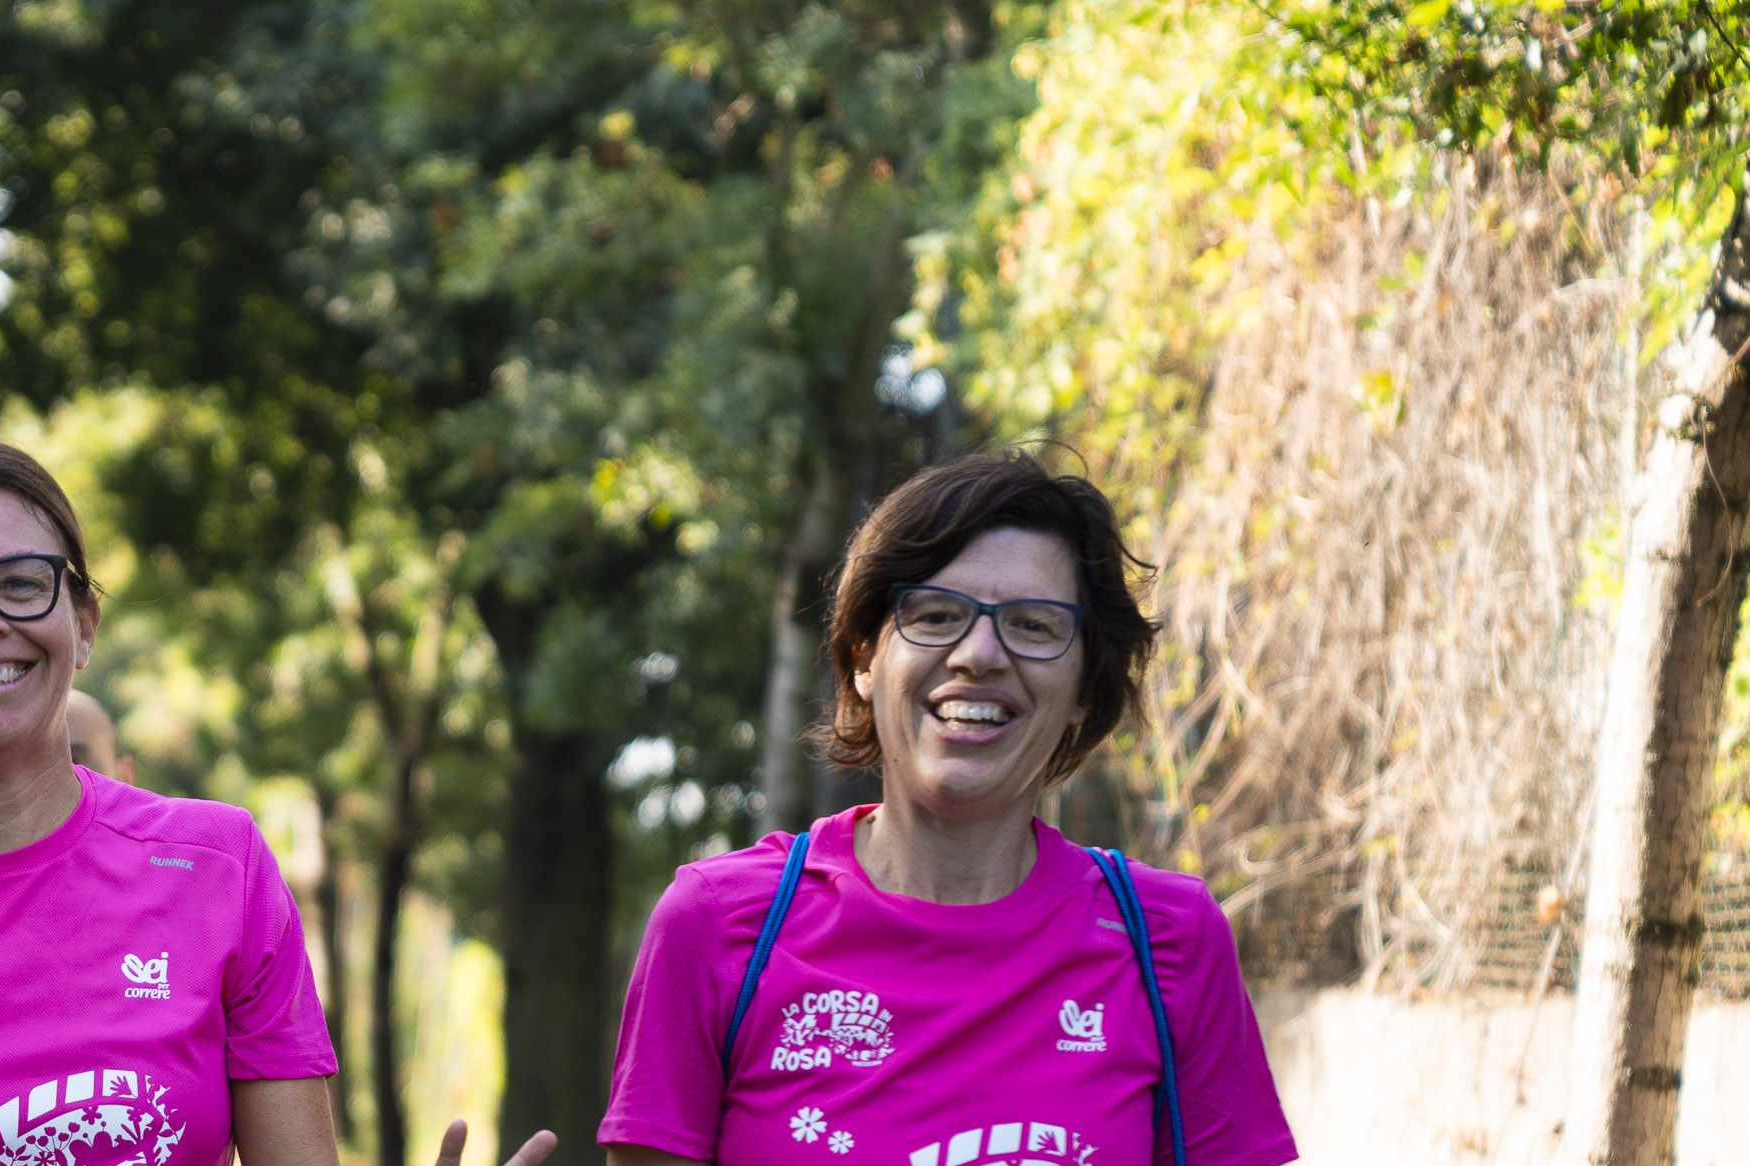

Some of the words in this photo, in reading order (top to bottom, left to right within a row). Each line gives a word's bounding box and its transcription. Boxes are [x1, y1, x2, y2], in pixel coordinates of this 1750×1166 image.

[150, 856, 194, 871] RUNNEK
[120, 951, 169, 984] Sei
[124, 987, 171, 999] correre
[781, 1003, 800, 1018] LA
[802, 989, 880, 1015] CORSA
[1058, 999, 1105, 1038] Sei
[771, 1045, 832, 1072] ROSA
[1056, 1039, 1107, 1052] correre
